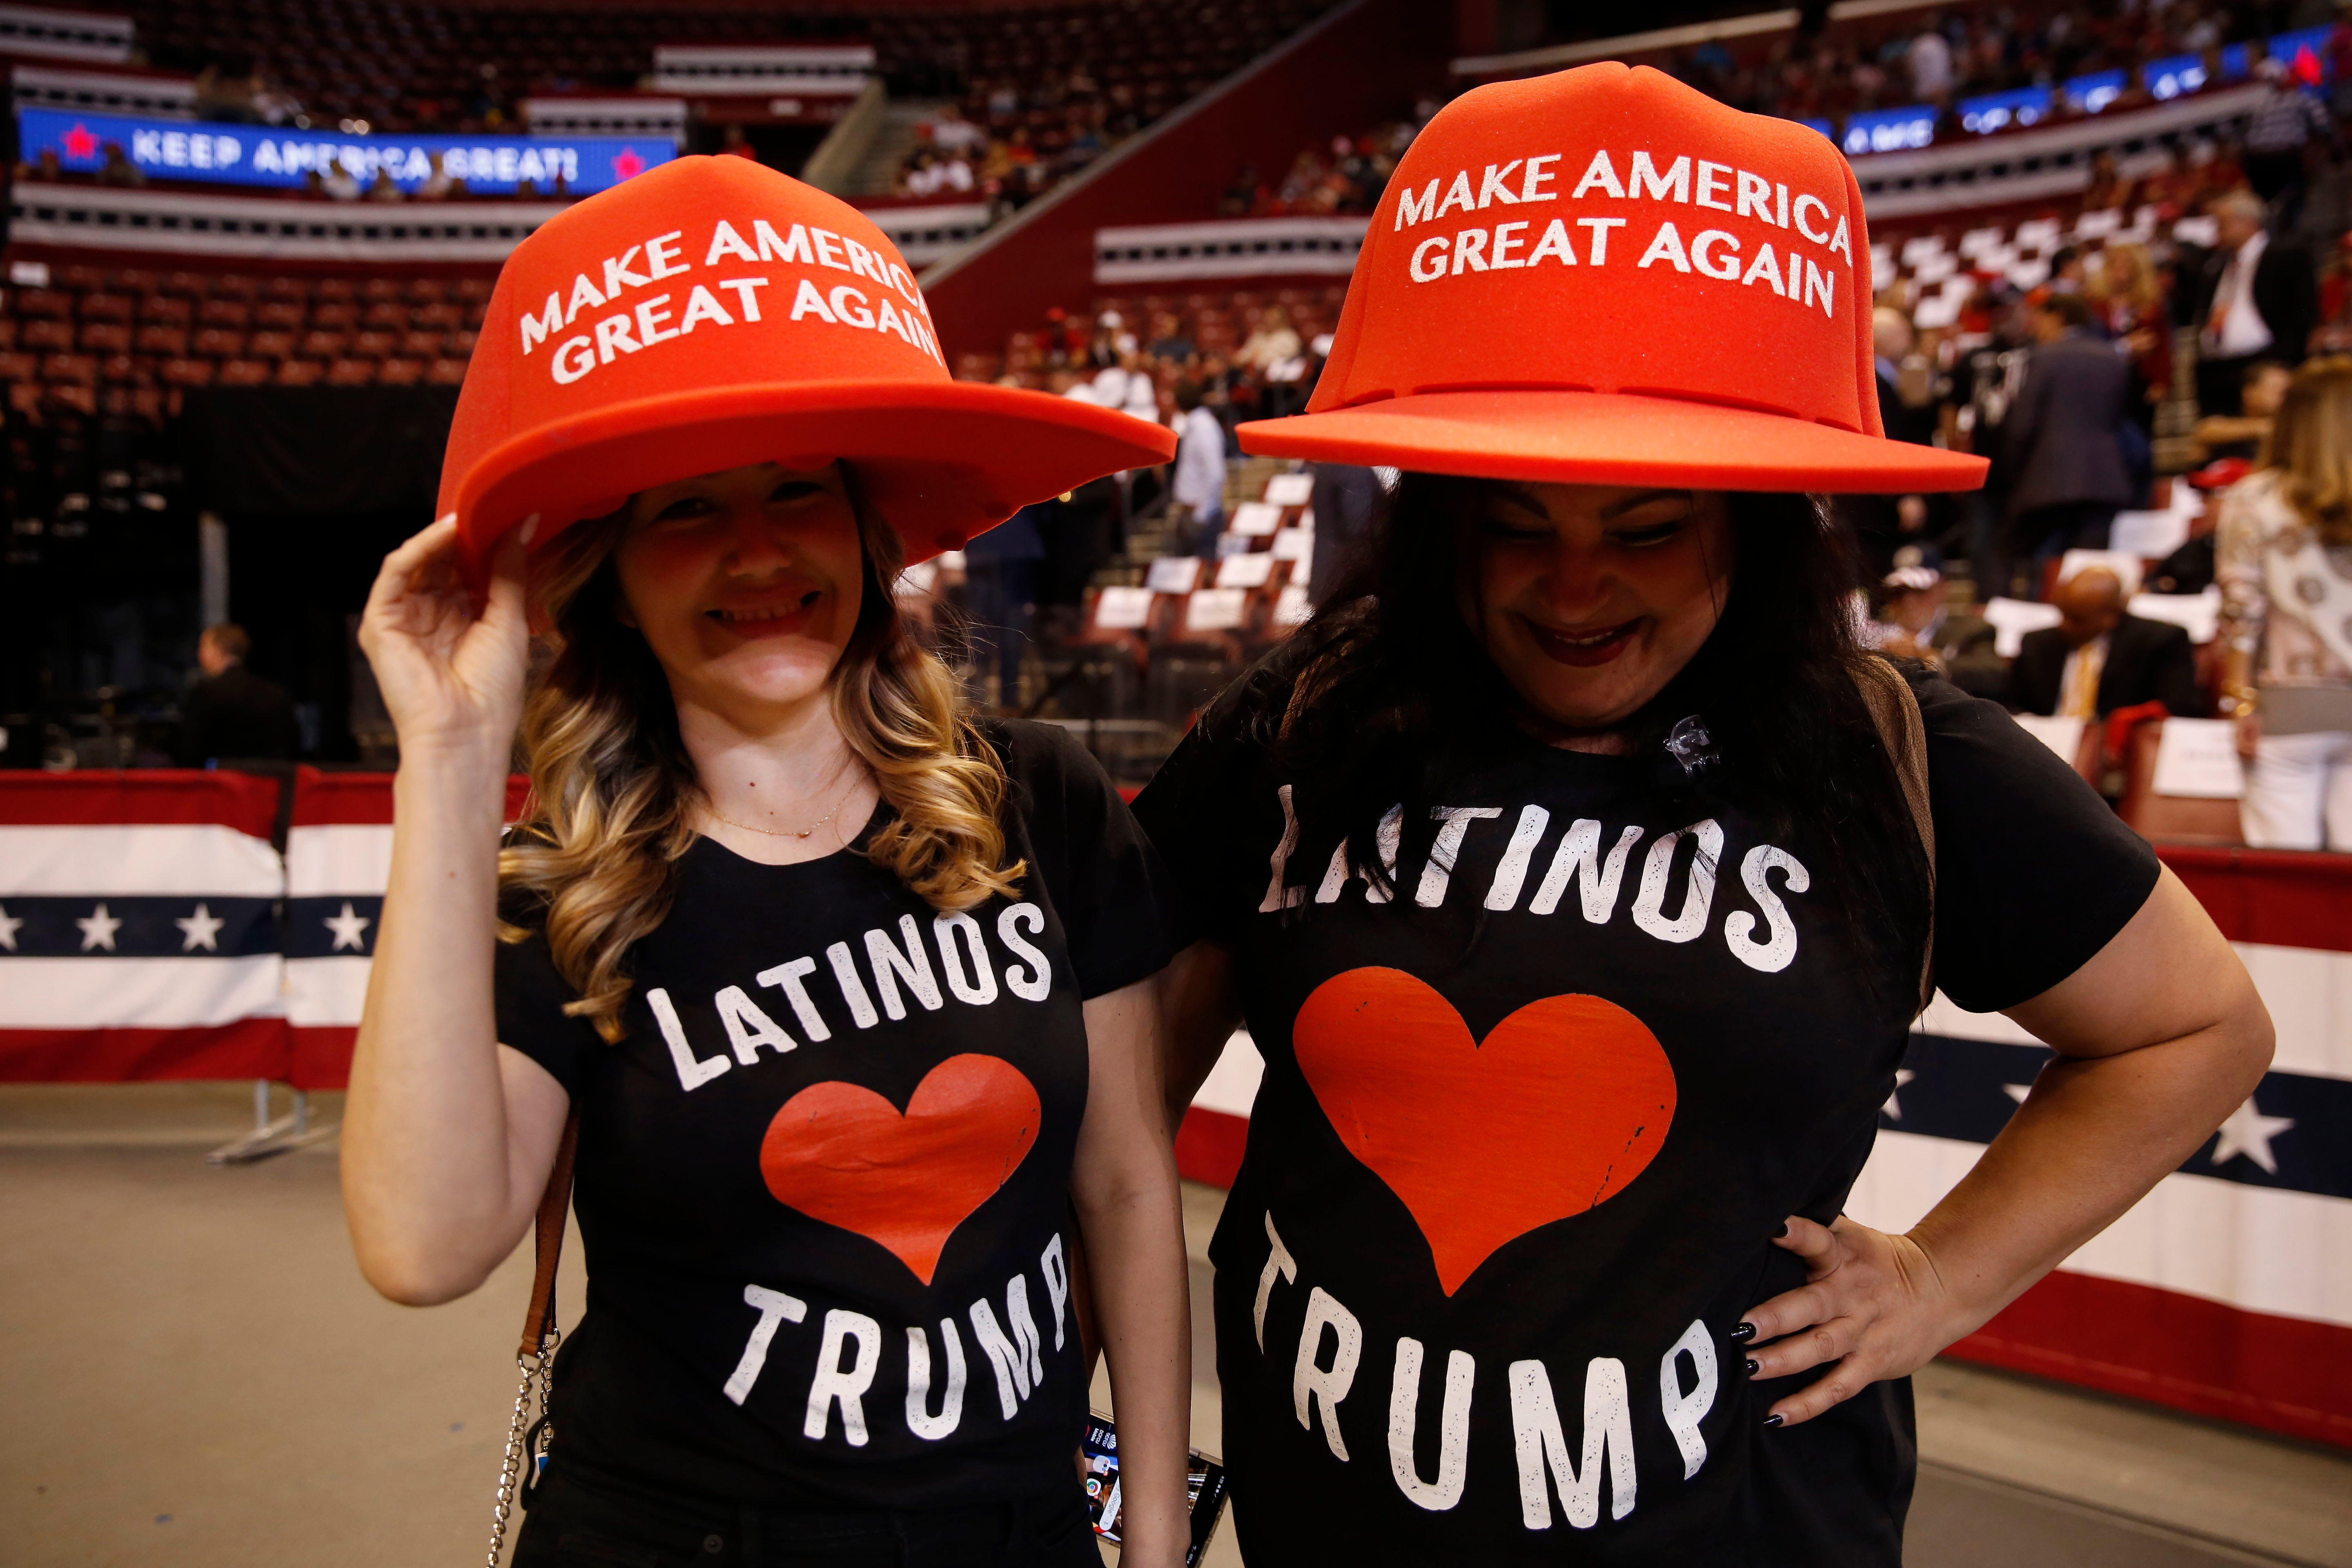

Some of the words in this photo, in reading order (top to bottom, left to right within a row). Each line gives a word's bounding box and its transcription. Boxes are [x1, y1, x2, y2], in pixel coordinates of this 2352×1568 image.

[133, 129, 243, 169] KEEP
[1394, 153, 1561, 232] MAKE
[1572, 149, 1852, 268] AMERICA
[519, 230, 690, 356] MAKE
[1409, 217, 1626, 283] GREAT
[1637, 221, 1834, 318] AGAIN
[551, 277, 769, 385] GREAT
[790, 279, 942, 367] AGAIN
[646, 902, 1051, 1091] LATINOS
[723, 1232, 1067, 1447] TRUMP
[1253, 1209, 1718, 1530] TRUMP
